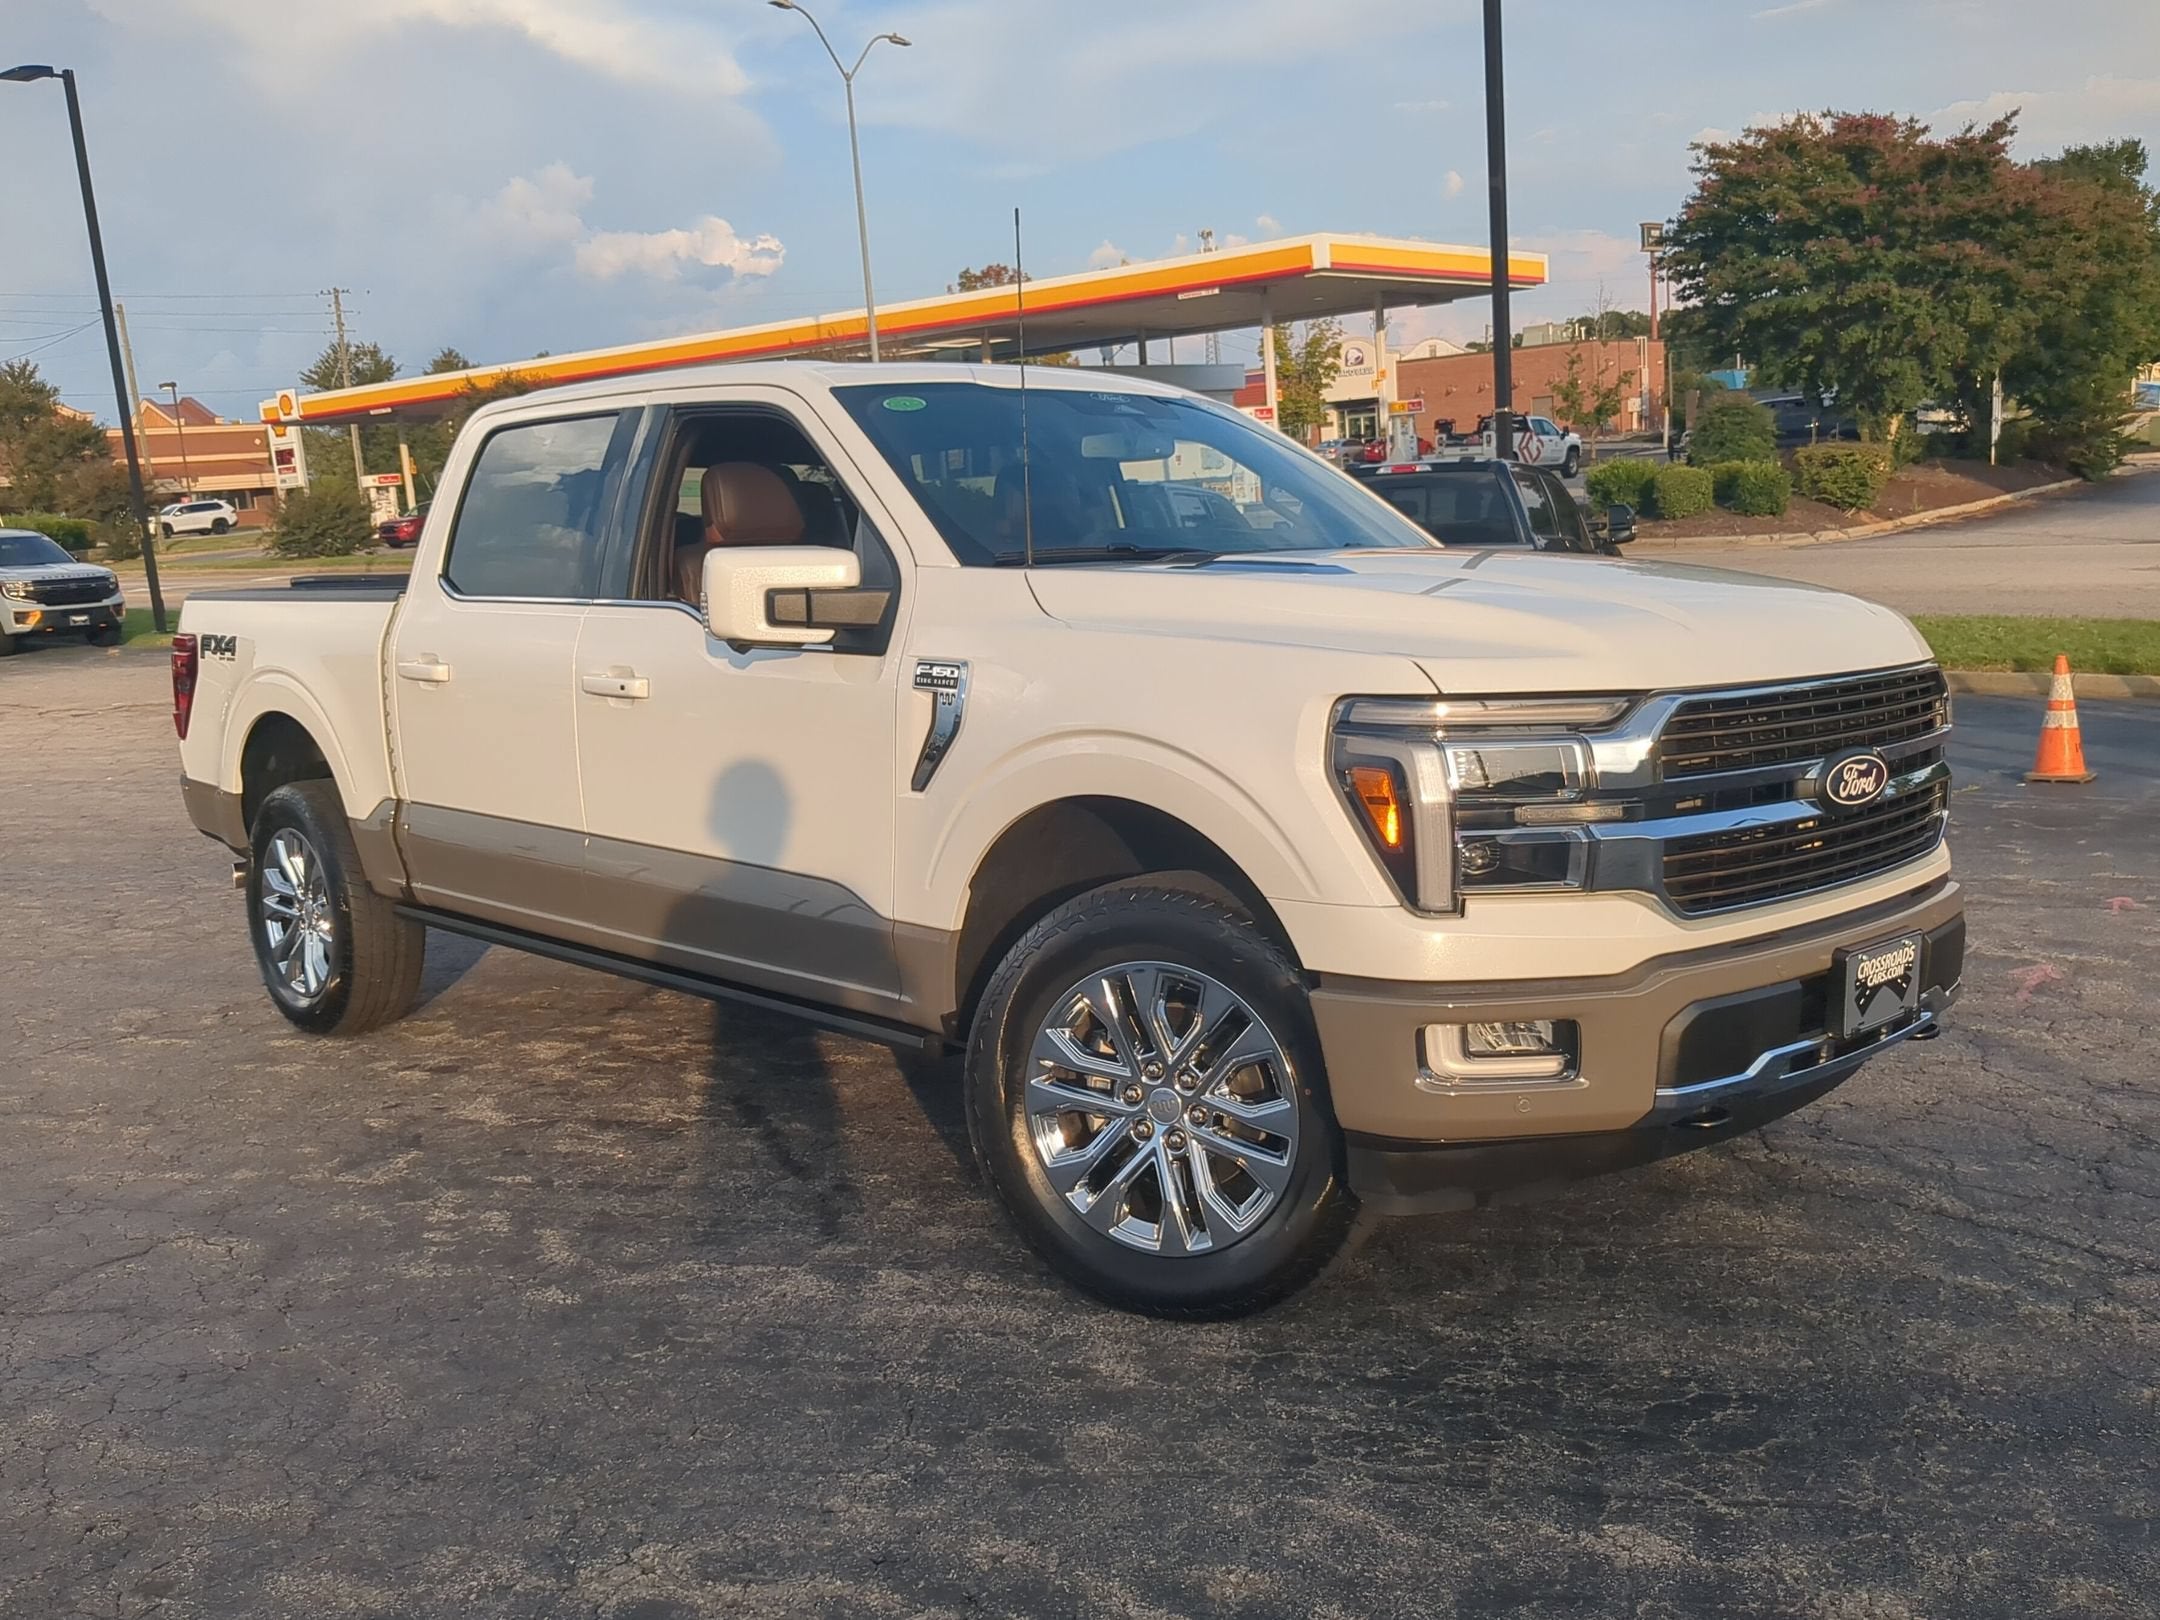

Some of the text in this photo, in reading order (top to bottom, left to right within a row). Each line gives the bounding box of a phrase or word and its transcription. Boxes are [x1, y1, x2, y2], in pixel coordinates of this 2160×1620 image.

[200, 634, 237, 659] FX4
[916, 664, 959, 678] F-150
[1839, 762, 1877, 798] Ford
[1857, 945, 1916, 979] CROSSROADS
[1867, 964, 1904, 987] CARS.COM
